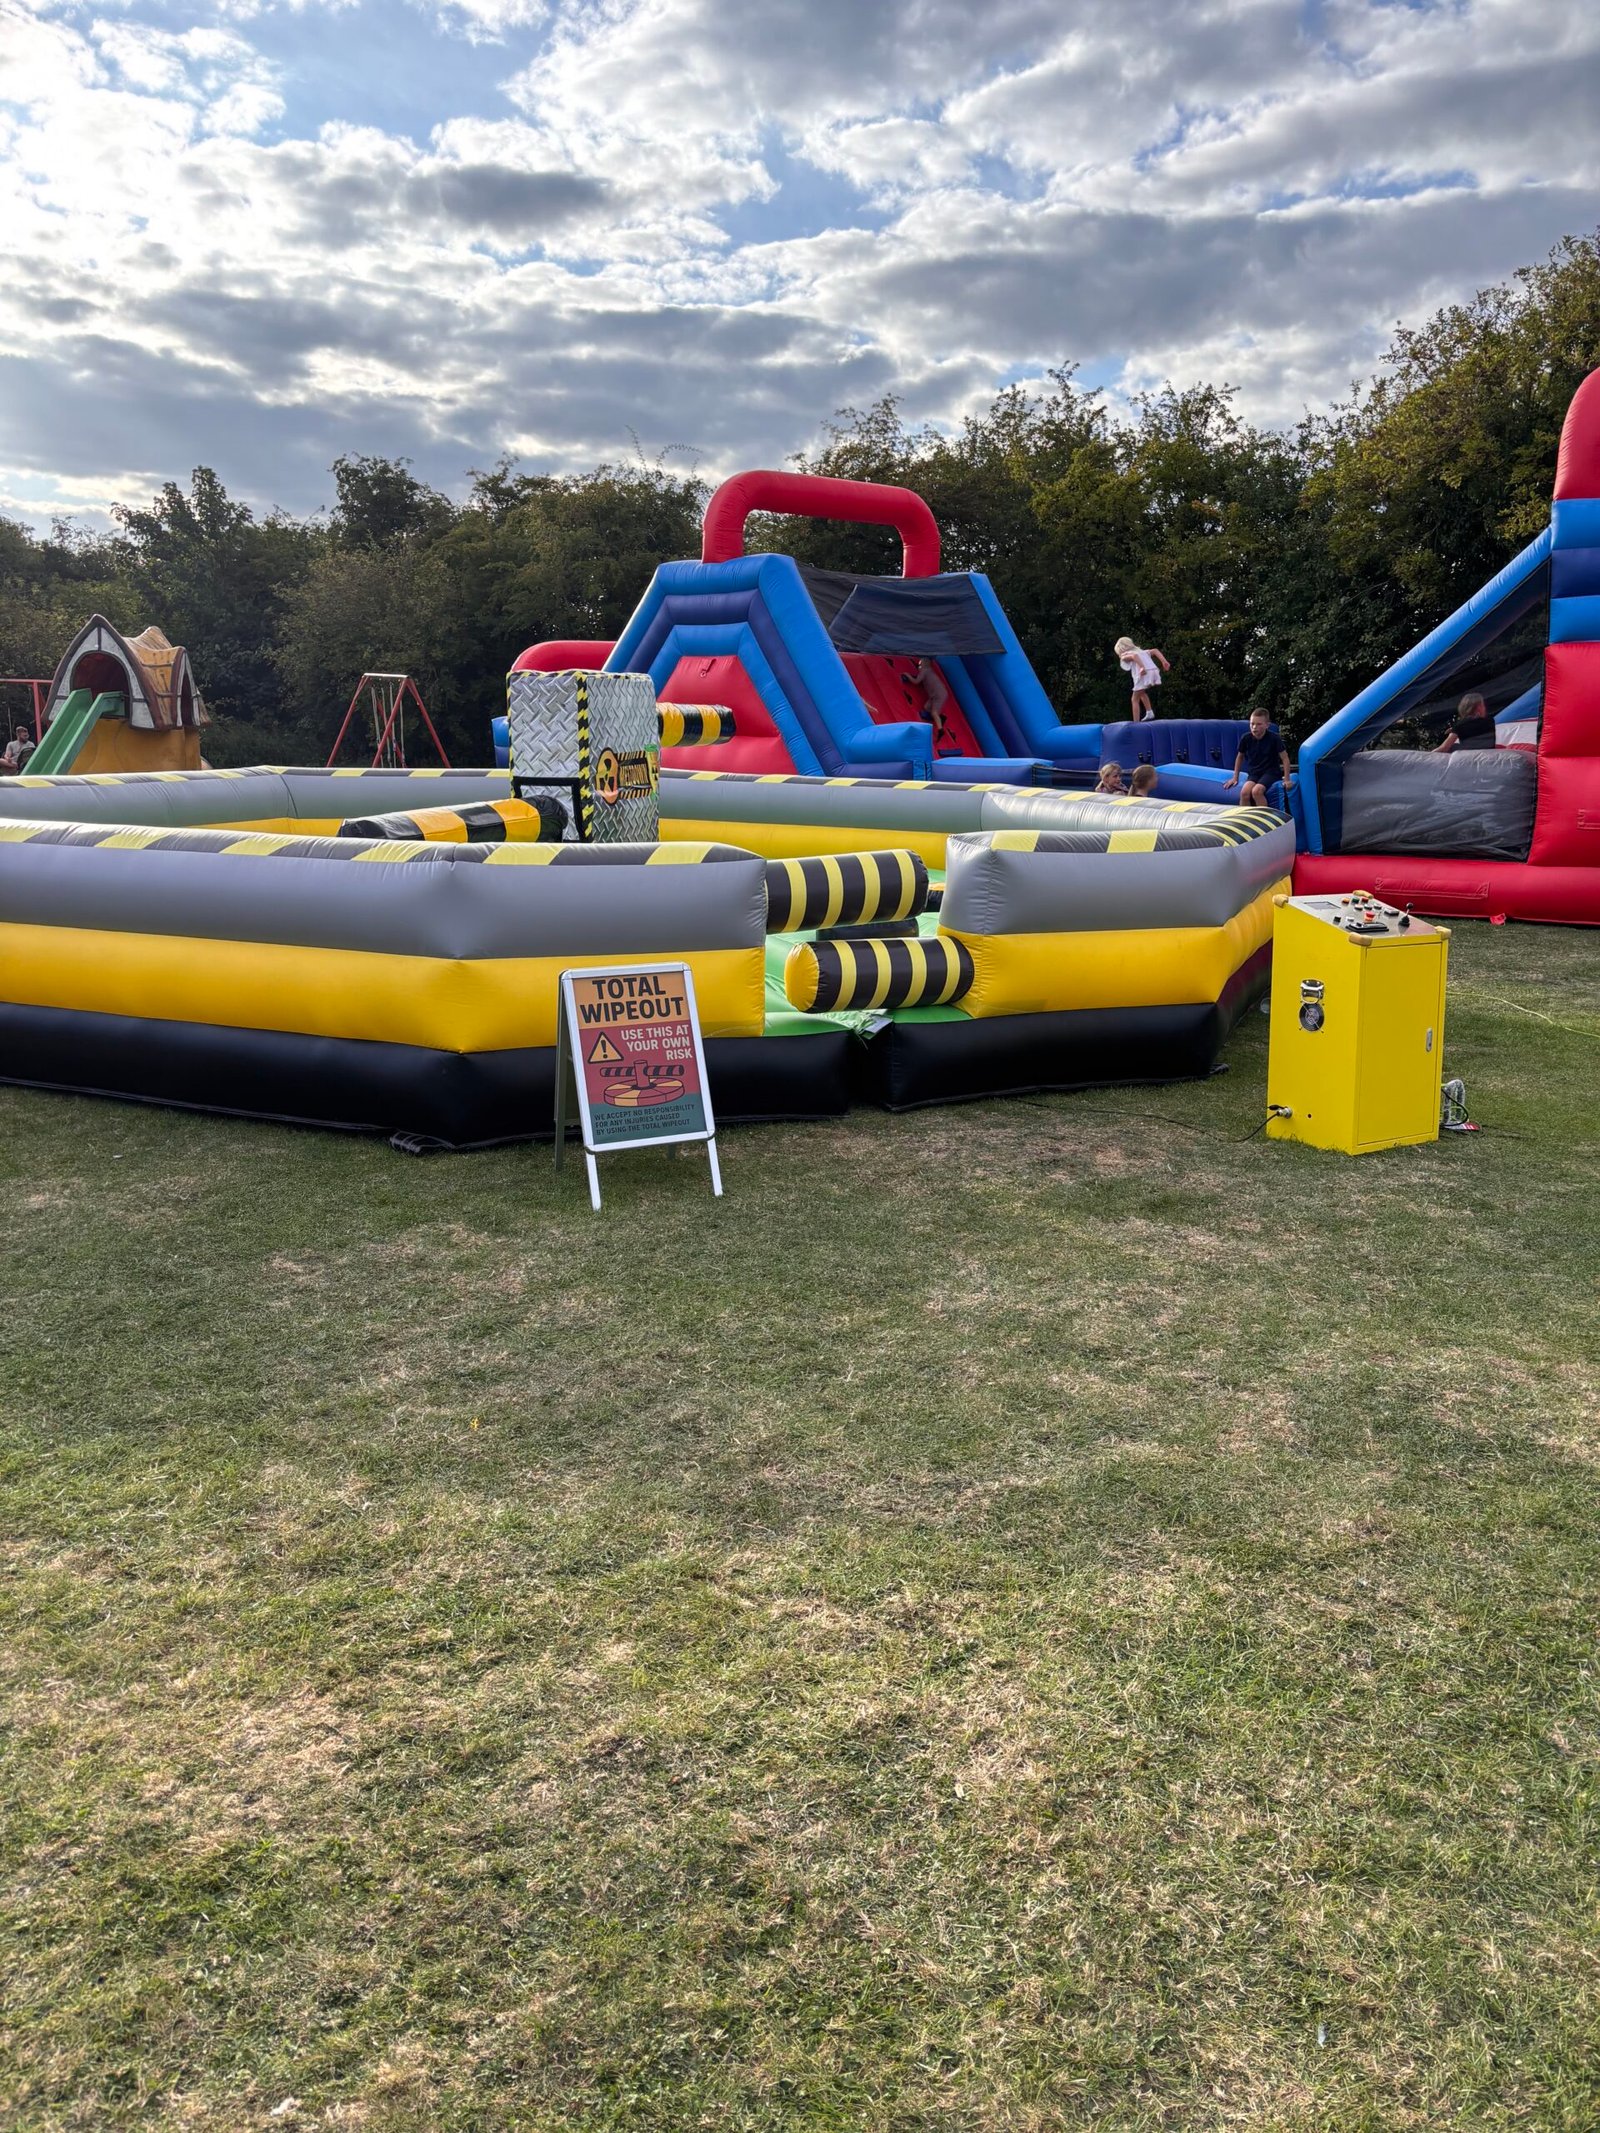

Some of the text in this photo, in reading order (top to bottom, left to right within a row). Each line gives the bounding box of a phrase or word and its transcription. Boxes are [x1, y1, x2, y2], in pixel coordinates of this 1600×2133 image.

[592, 976, 666, 999] TOTAL
[580, 997, 683, 1023] WIPEOUT
[621, 1025, 689, 1040] USE THIS AT
[627, 1036, 690, 1052] YOUR OWN
[666, 1048, 693, 1060] RISK
[594, 1104, 695, 1121] WE ACCEPT NO RESPONSIBILITY
[595, 1112, 680, 1128] FOR ANY INJURIES CAUSED
[596, 1119, 691, 1136] BY USING THE TOTAL WIPEOUT
